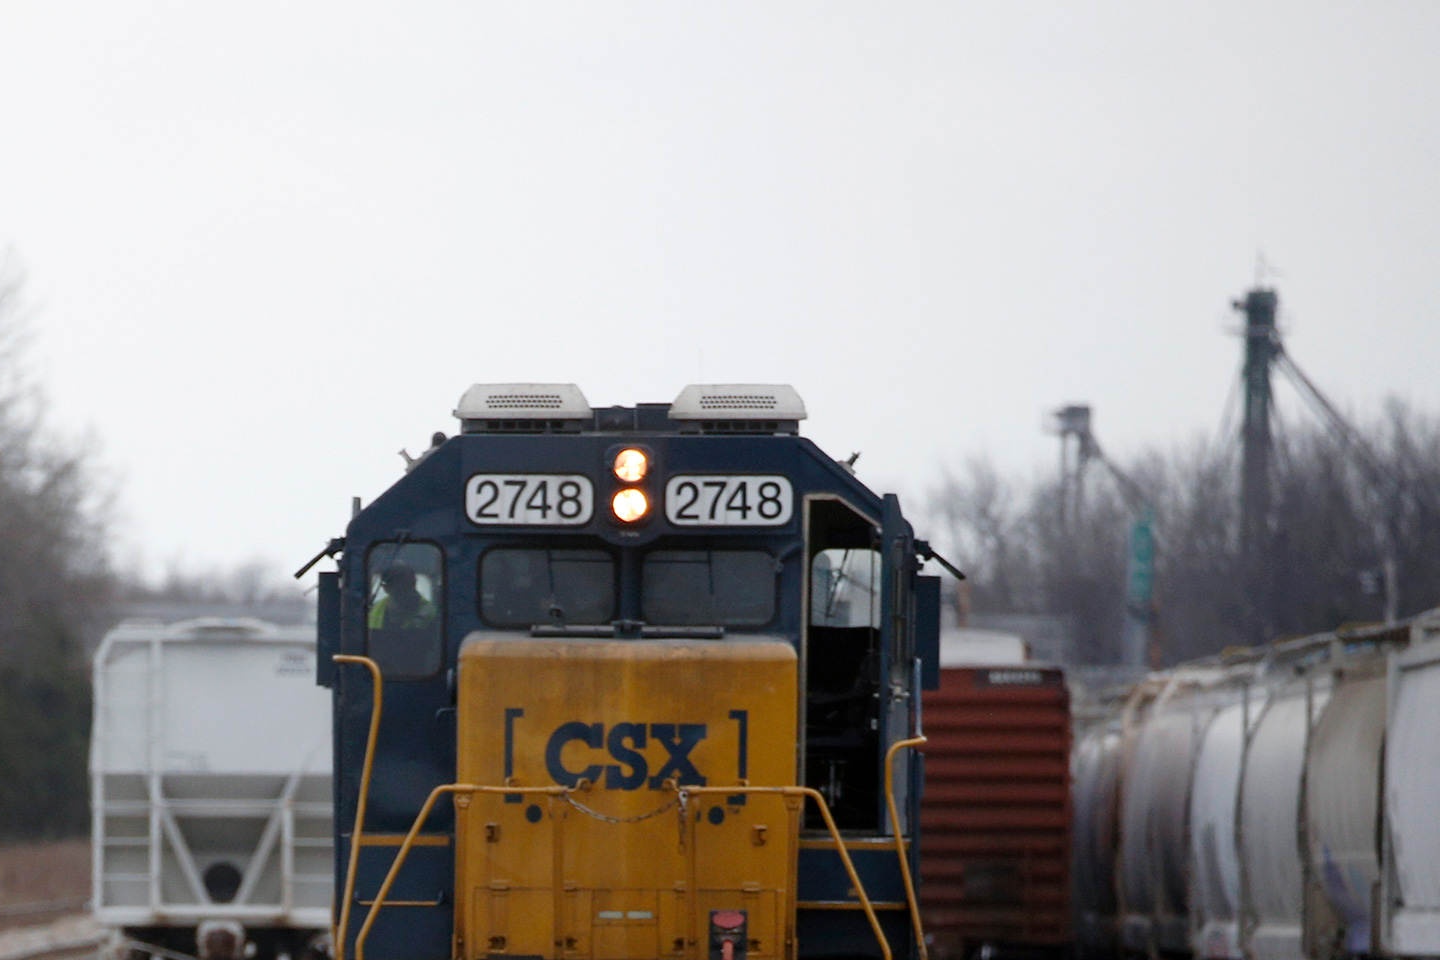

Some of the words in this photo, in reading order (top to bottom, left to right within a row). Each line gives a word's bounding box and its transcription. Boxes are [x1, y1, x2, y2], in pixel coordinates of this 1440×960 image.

[475, 480, 582, 519] 2748
[675, 481, 782, 520] 2748
[545, 721, 707, 791] CSX
